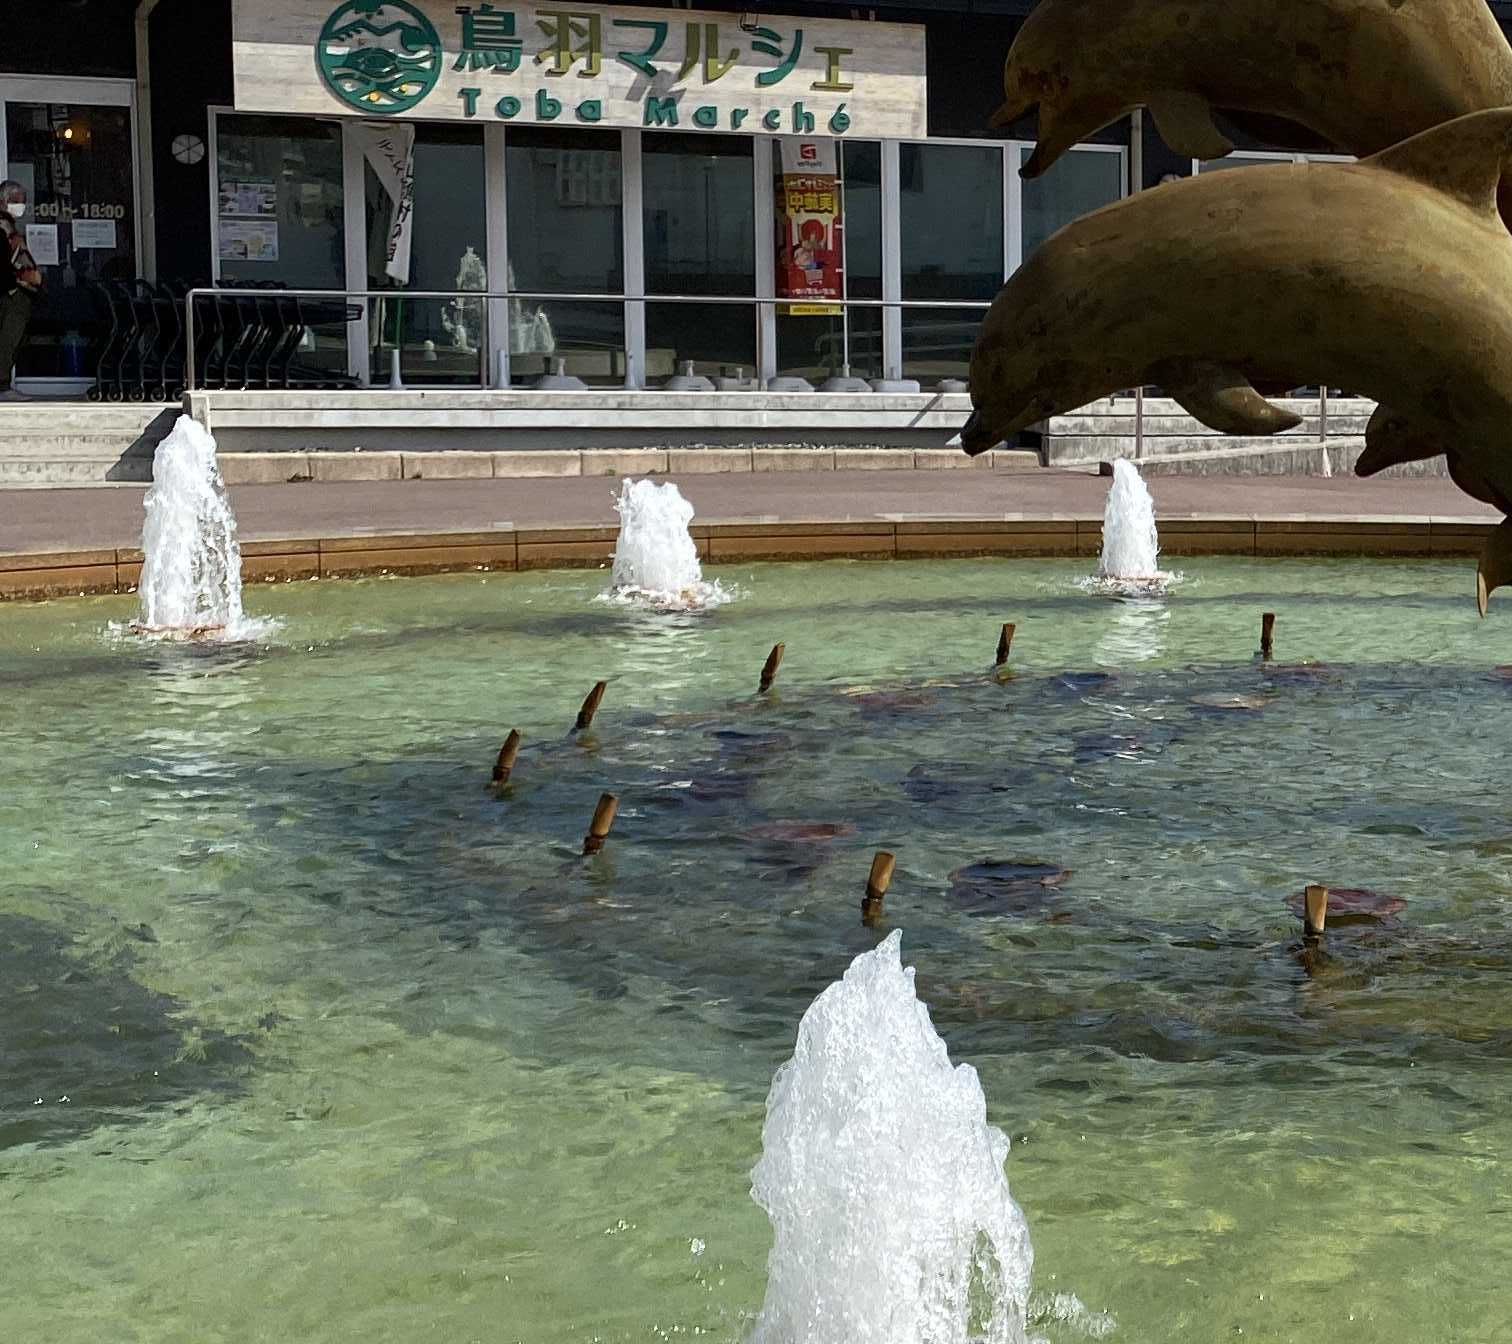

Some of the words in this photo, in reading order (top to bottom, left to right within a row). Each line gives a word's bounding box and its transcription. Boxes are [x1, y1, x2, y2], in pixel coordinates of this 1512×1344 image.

[453, 4, 854, 90] 鳥羽マルシェ
[458, 88, 602, 123] Toba
[643, 97, 850, 133] Marché
